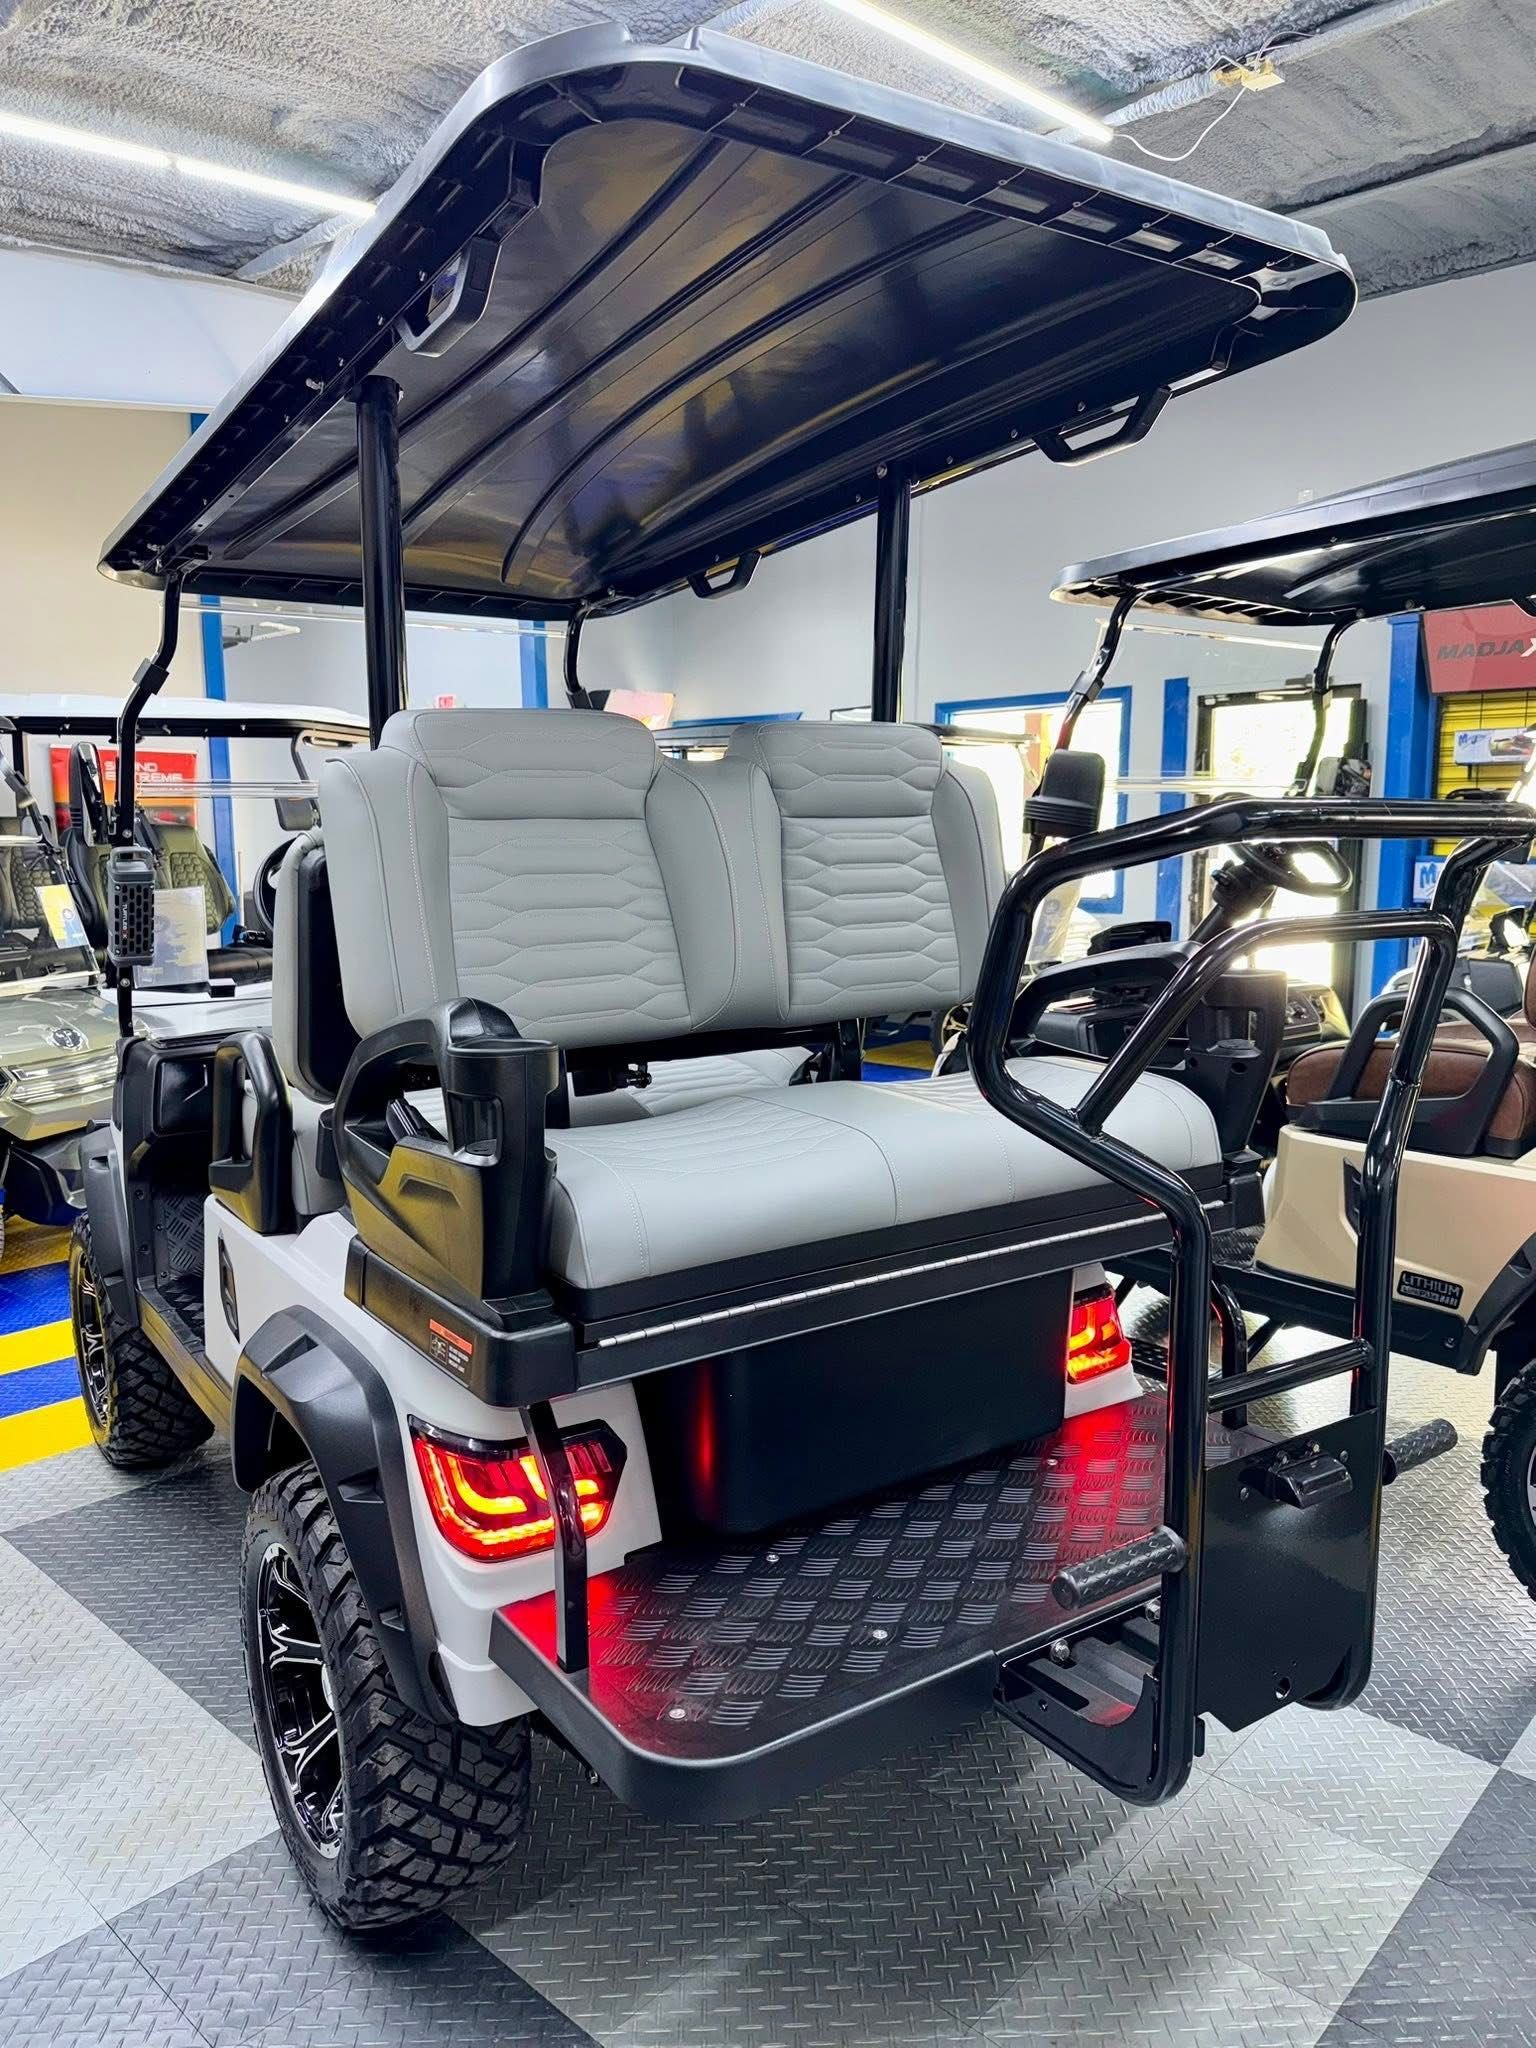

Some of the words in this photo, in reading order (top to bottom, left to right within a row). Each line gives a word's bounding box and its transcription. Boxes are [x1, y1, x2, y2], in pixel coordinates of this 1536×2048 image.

[105, 761, 158, 773] SND
[105, 771, 183, 783] EREME
[1402, 1273, 1461, 1297] LITHIUM
